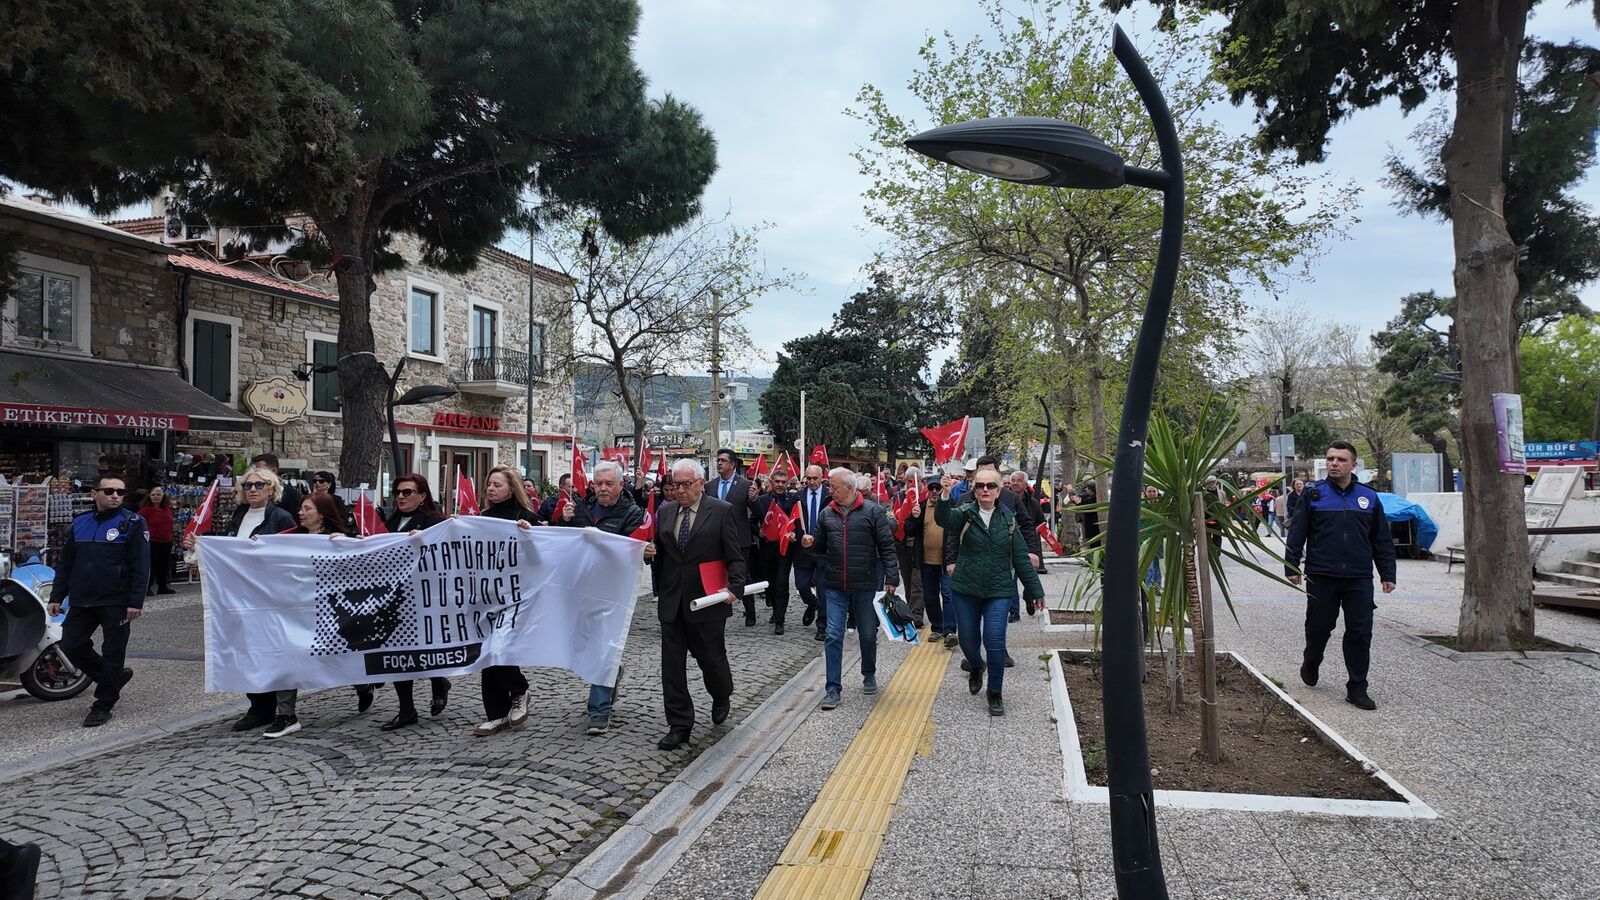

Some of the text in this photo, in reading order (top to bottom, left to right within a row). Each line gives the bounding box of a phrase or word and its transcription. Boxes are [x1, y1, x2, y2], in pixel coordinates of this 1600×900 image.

[4, 406, 174, 429] ETİKETİN YARISI
[432, 411, 500, 431] AKBANK
[1547, 443, 1576, 451] BÜFE
[418, 536, 518, 572] ATATÜRKÇÜ
[421, 572, 522, 608] DÜŞÜNCE
[382, 646, 468, 671] FOÇA ŞUBESİ
